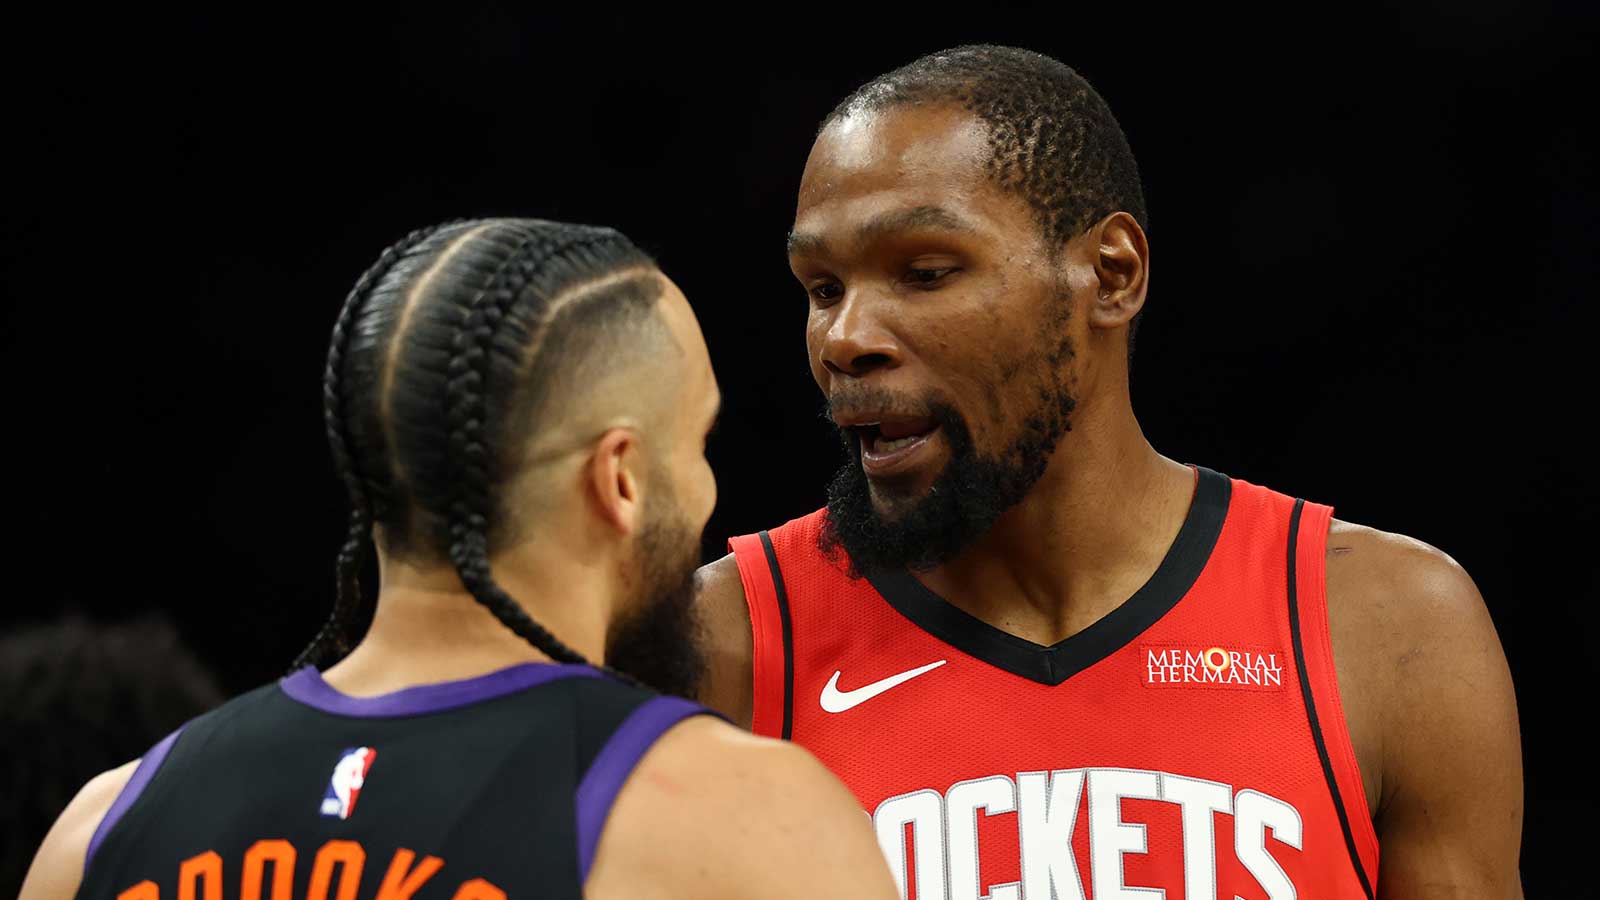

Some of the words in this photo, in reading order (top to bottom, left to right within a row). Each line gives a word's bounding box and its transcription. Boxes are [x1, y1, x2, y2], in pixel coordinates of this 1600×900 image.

[1147, 647, 1282, 670] MEMORIAL
[1148, 666, 1281, 686] HERMANN
[863, 767, 1303, 900] OCKETS
